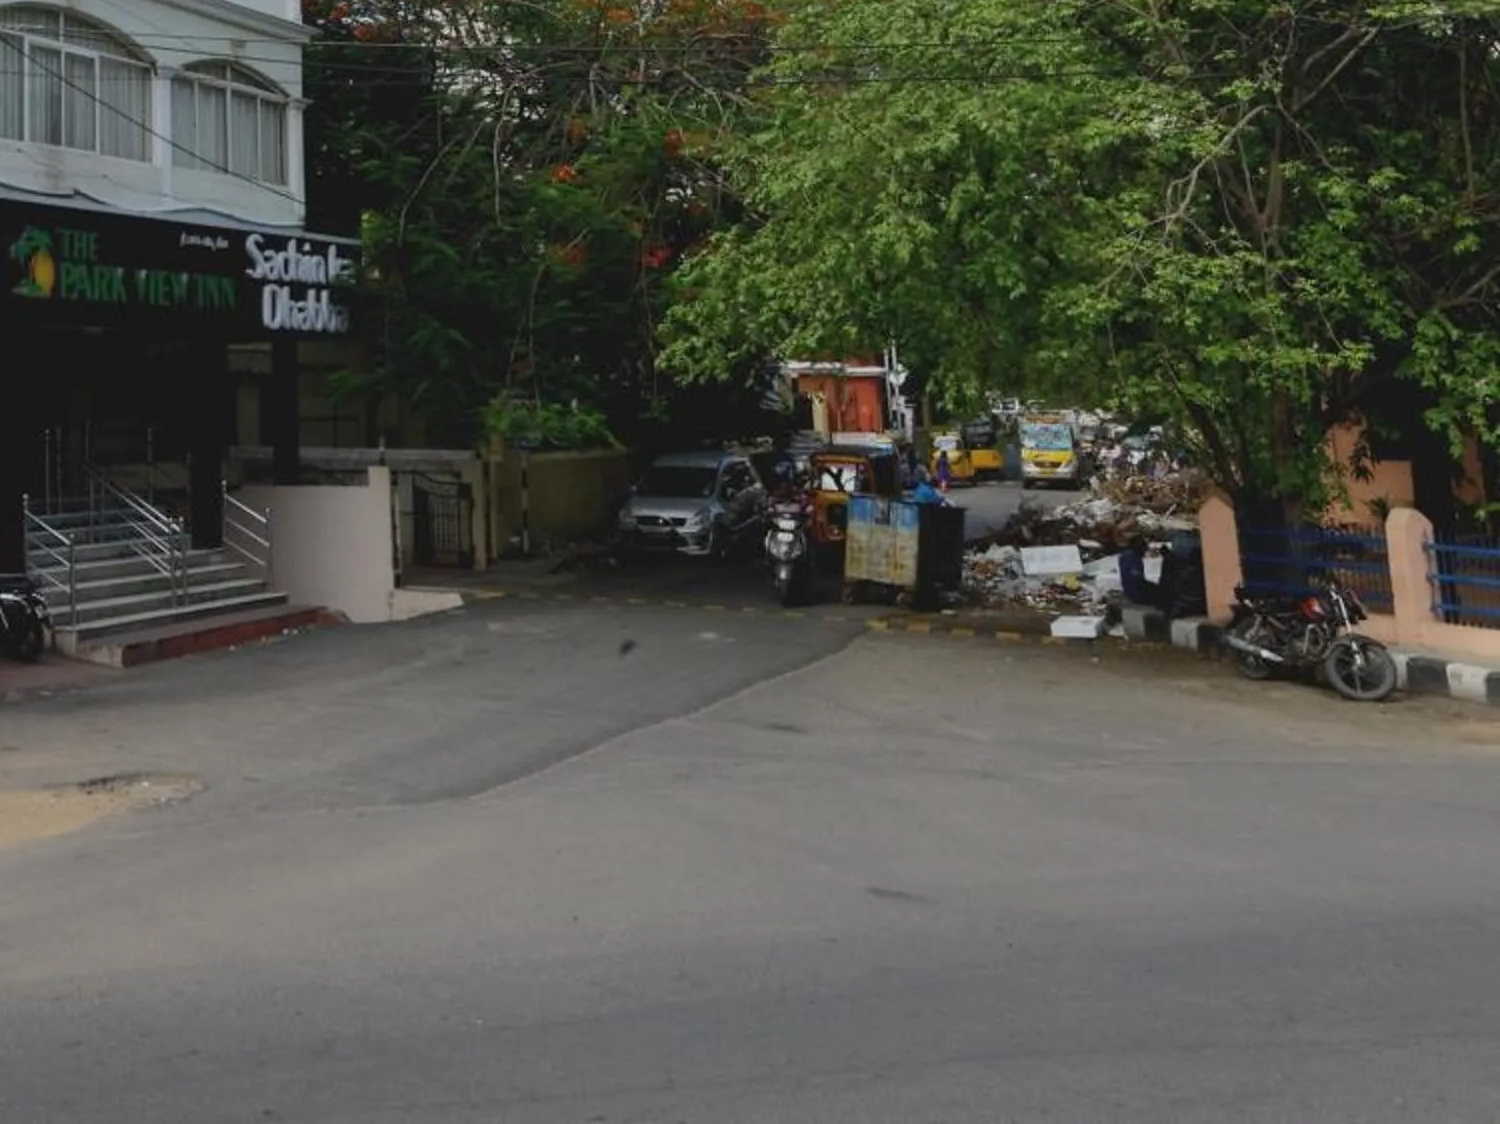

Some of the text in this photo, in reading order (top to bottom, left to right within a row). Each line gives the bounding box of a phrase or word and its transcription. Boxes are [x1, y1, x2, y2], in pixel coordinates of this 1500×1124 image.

[58, 229, 100, 263] THE
[244, 233, 326, 284] Sachin
[327, 244, 357, 286] ka
[60, 262, 238, 311] PARK VIEW INN
[262, 284, 351, 333] Dhabba
